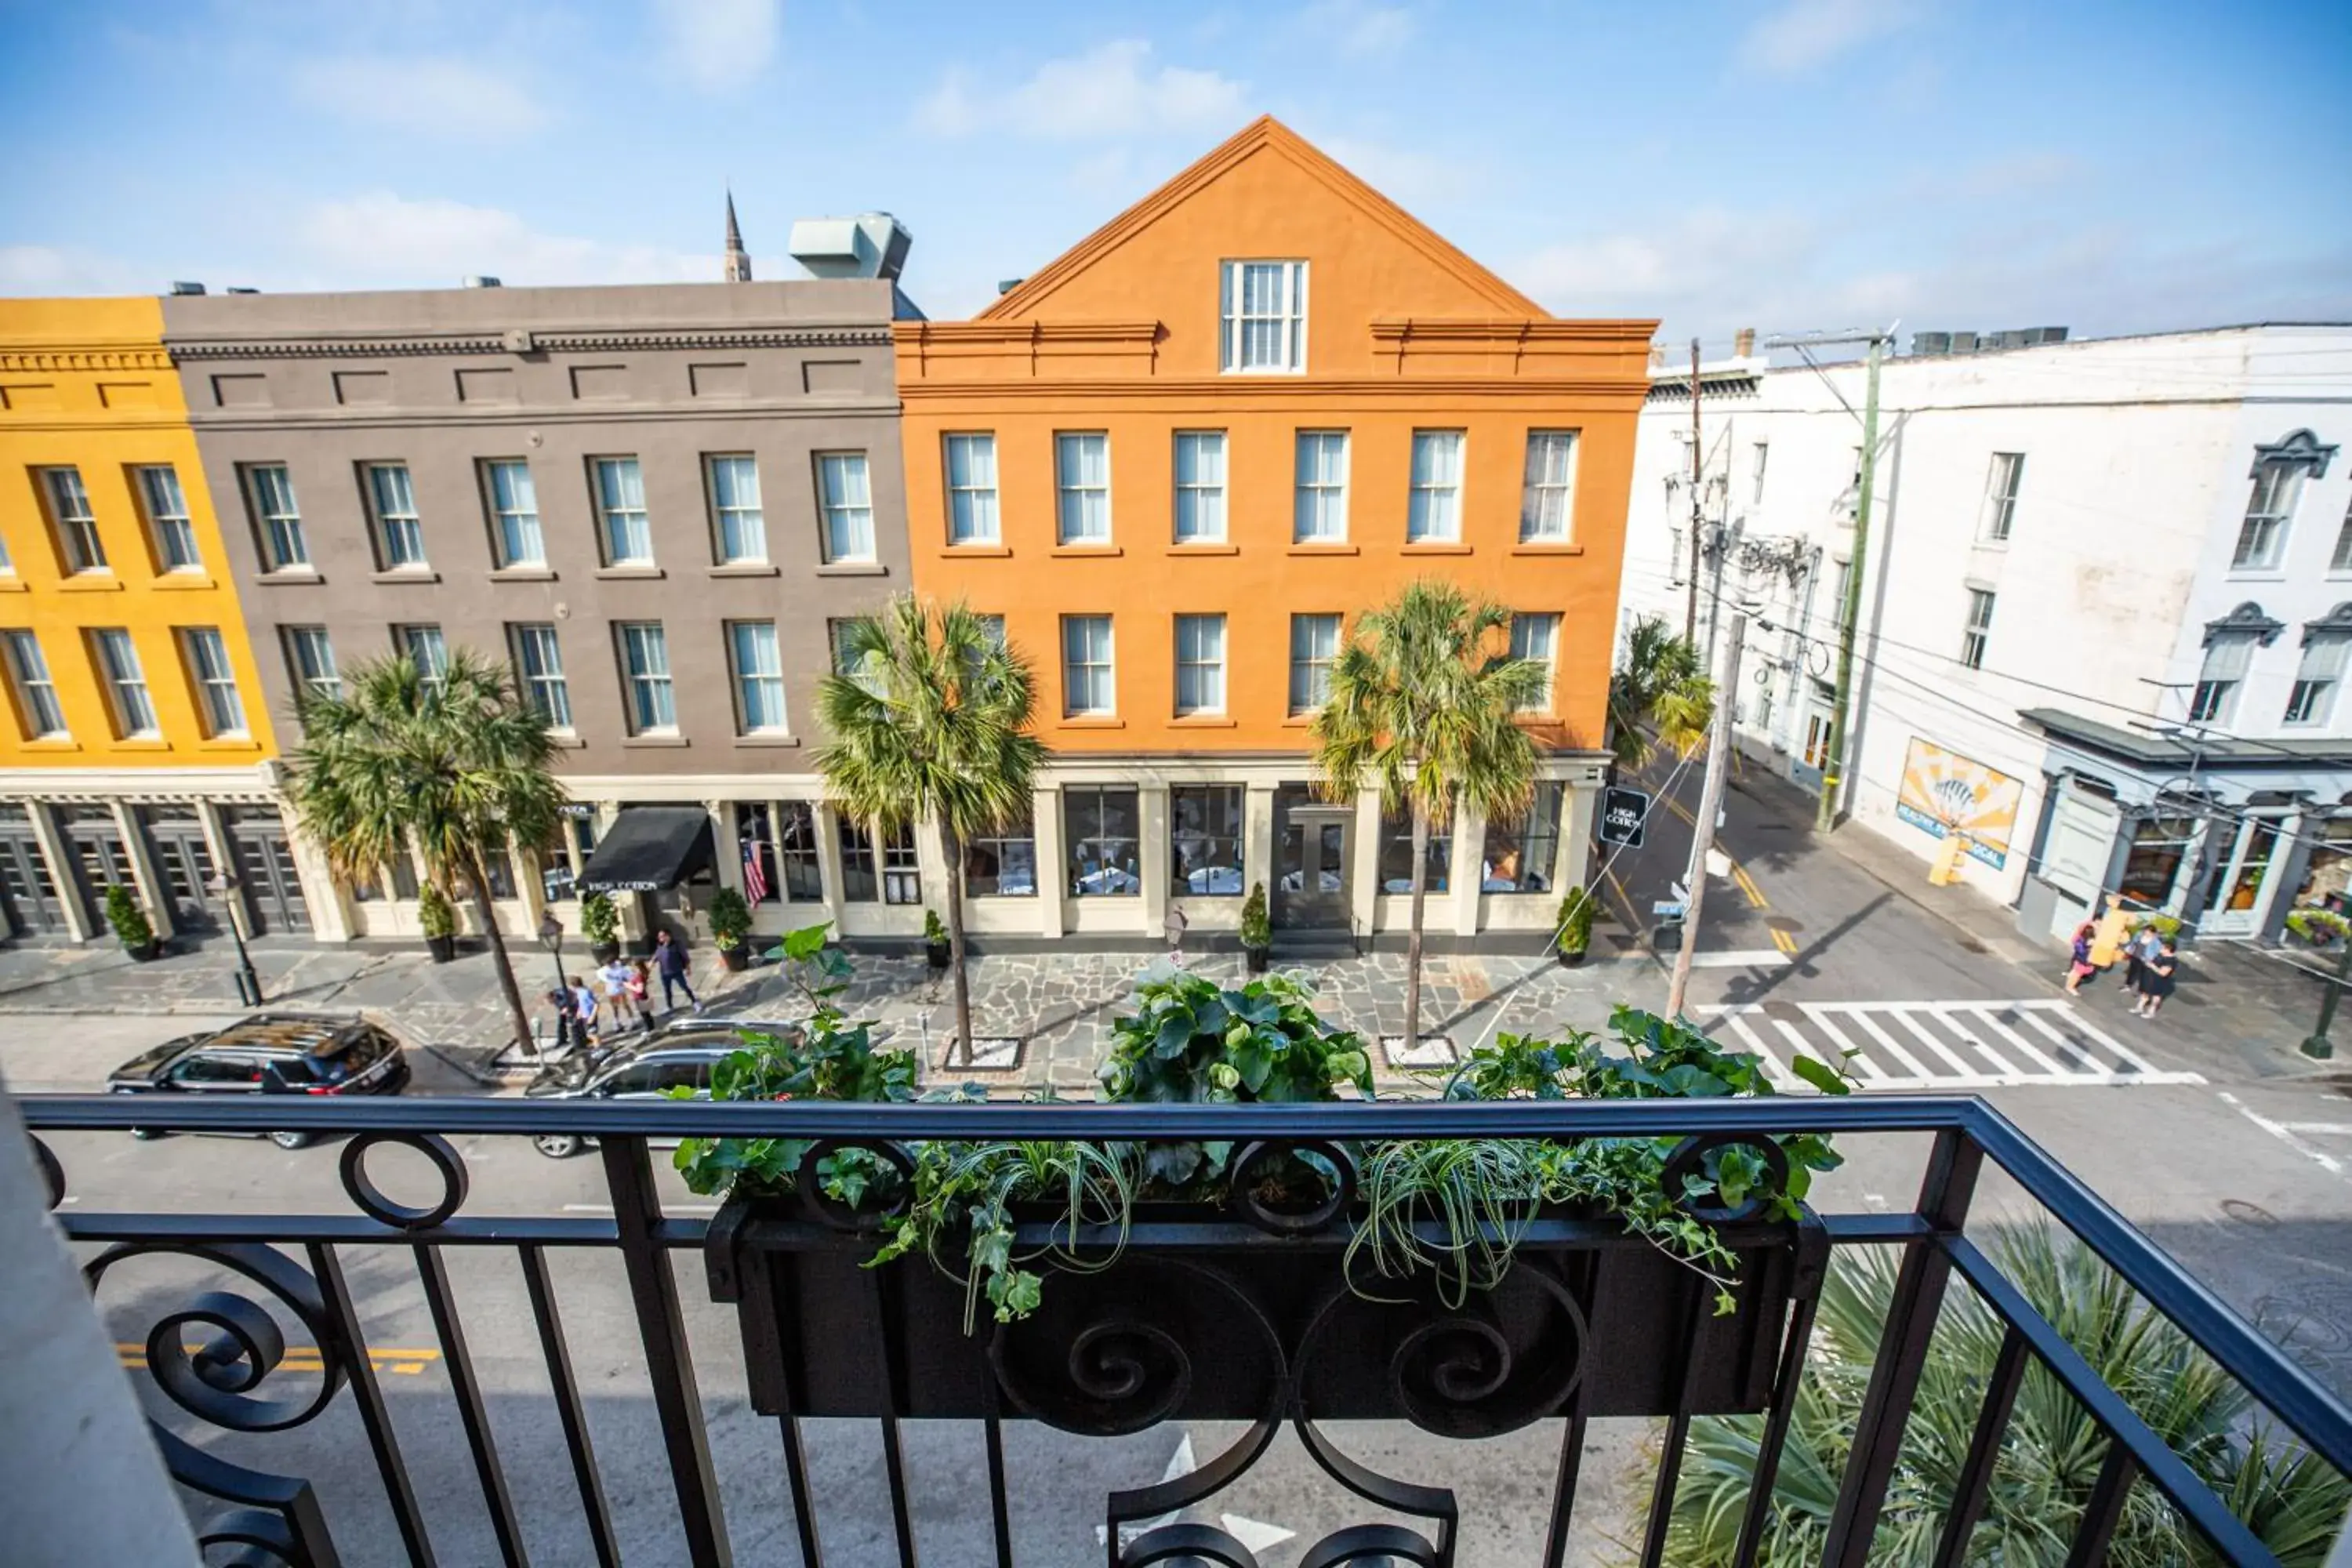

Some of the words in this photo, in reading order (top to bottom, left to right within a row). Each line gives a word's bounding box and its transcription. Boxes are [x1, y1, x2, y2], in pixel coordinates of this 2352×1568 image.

[1613, 807, 1636, 819] HIGH
[1606, 814, 1641, 829] COTTON
[589, 881, 614, 891] HIGH
[617, 880, 657, 891] COTTON
